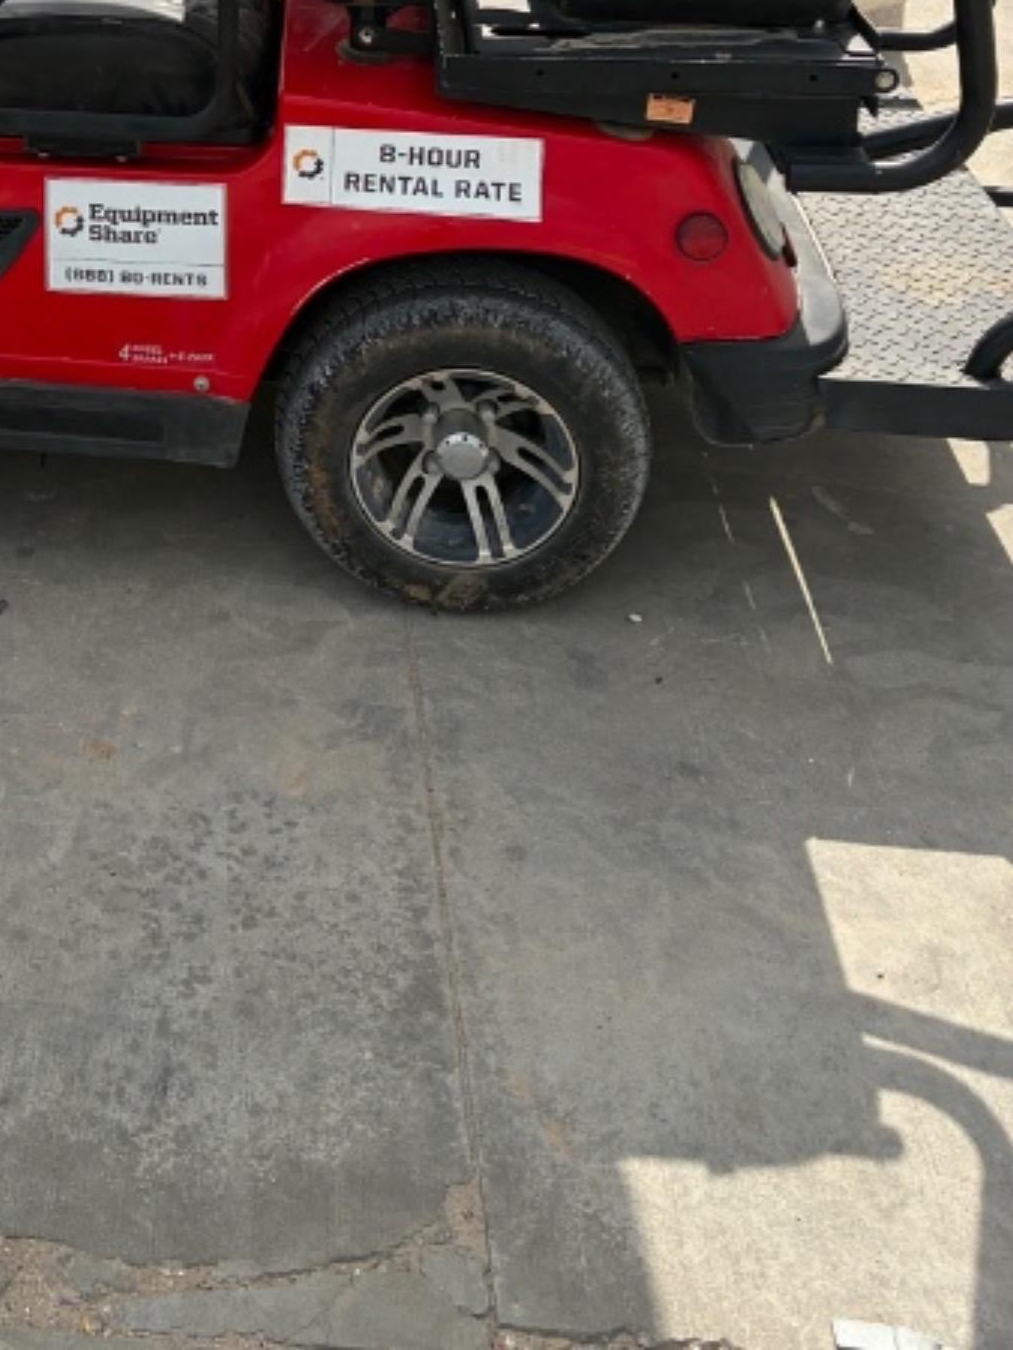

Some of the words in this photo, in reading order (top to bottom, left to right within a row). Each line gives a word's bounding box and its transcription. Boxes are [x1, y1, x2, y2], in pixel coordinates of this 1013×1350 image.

[379, 144, 481, 170] 8-HOUR
[343, 172, 443, 199] RENTAL
[454, 180, 523, 202] RATE
[88, 203, 219, 227] Equipment
[89, 225, 158, 244] Share
